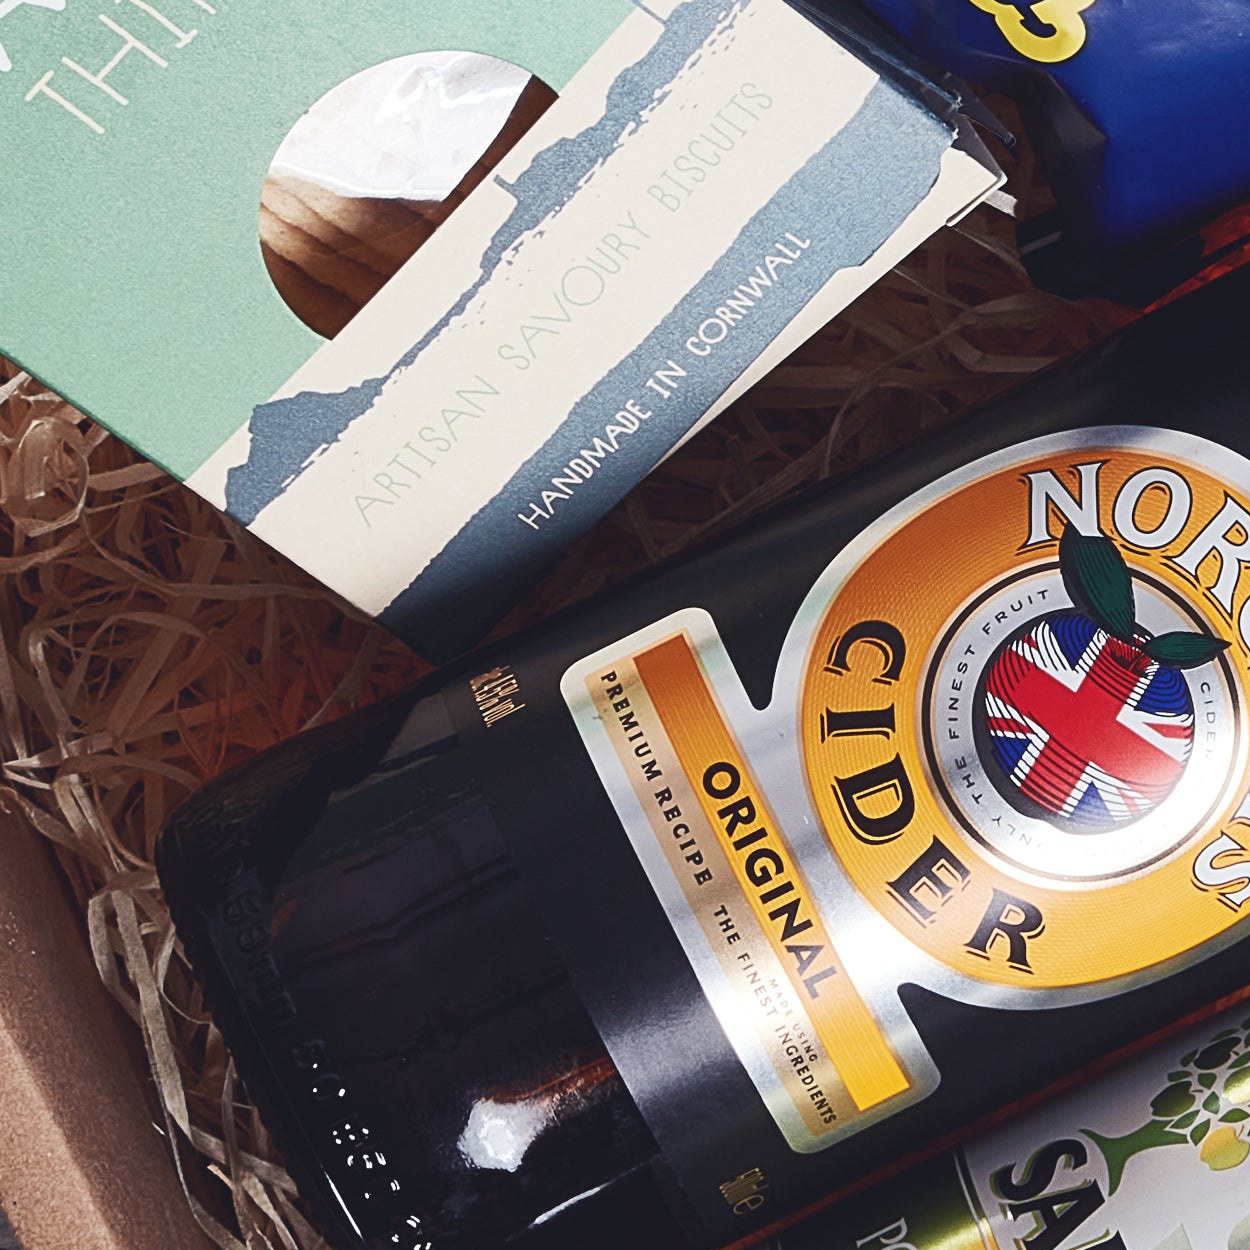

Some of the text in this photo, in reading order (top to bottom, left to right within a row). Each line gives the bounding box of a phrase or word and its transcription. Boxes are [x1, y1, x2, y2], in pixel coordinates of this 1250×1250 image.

[25, 0, 216, 134] THI
[354, 82, 773, 528] ARTISAN SAVOURY BISCUITS
[517, 232, 811, 530] HANDMADE IN CORNWALL
[948, 644, 976, 740] FINEST
[982, 589, 1049, 635] FRUIT
[600, 670, 713, 886] PREMIUM RECIPE
[702, 761, 837, 1000] ORIGINAL
[821, 619, 1046, 974] CIDER
[955, 755, 984, 805] THE
[713, 904, 837, 1125] THE FINEST INGREDIENTS
[768, 978, 818, 1062] MADE USING
